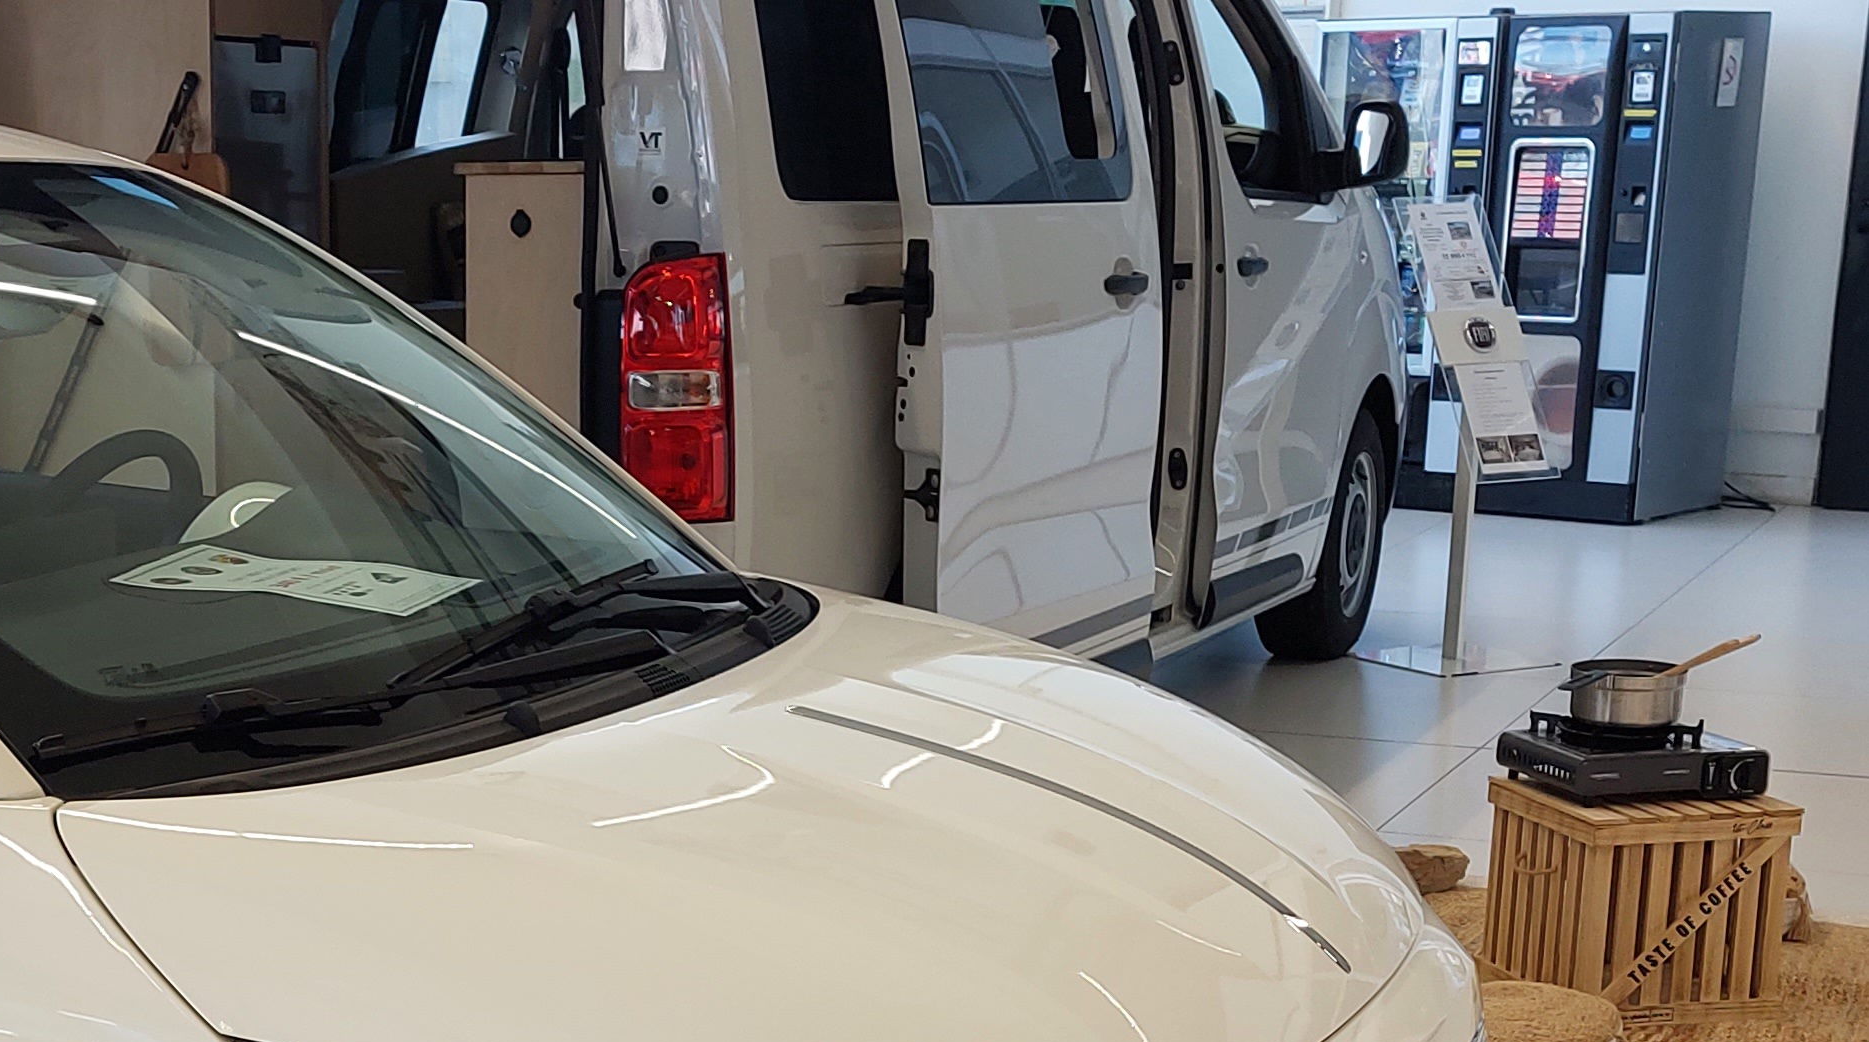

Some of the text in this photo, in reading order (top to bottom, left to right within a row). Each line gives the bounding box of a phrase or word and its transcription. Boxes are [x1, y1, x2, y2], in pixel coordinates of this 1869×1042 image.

[639, 131, 663, 149] VT
[1627, 862, 1752, 984] TASTE OF COFFEE
